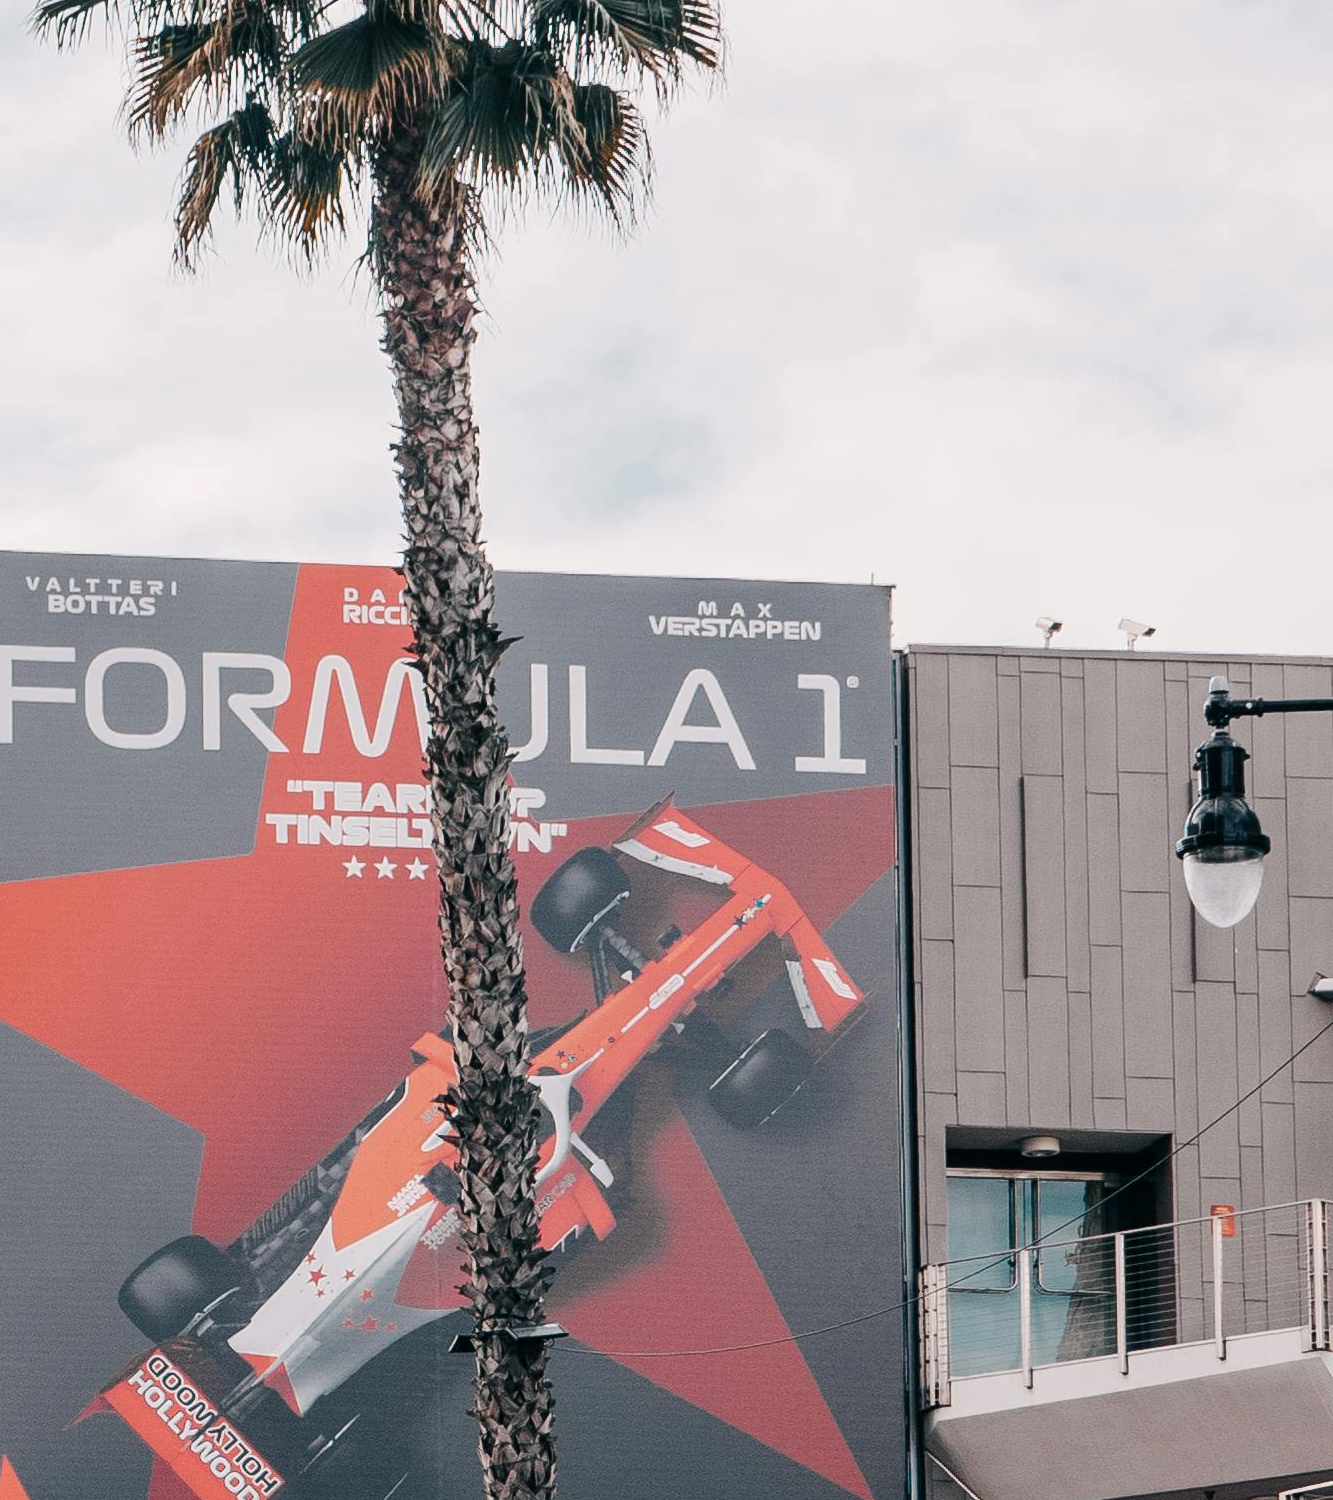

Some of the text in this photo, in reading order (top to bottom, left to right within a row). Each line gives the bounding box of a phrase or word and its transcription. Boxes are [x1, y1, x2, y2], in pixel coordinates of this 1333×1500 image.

[26, 576, 177, 596] VALTTERI
[47, 595, 156, 616] BOTTAS
[698, 601, 772, 618] MAX
[649, 616, 821, 640] VERSTAPPEN
[509, 787, 546, 818] P
